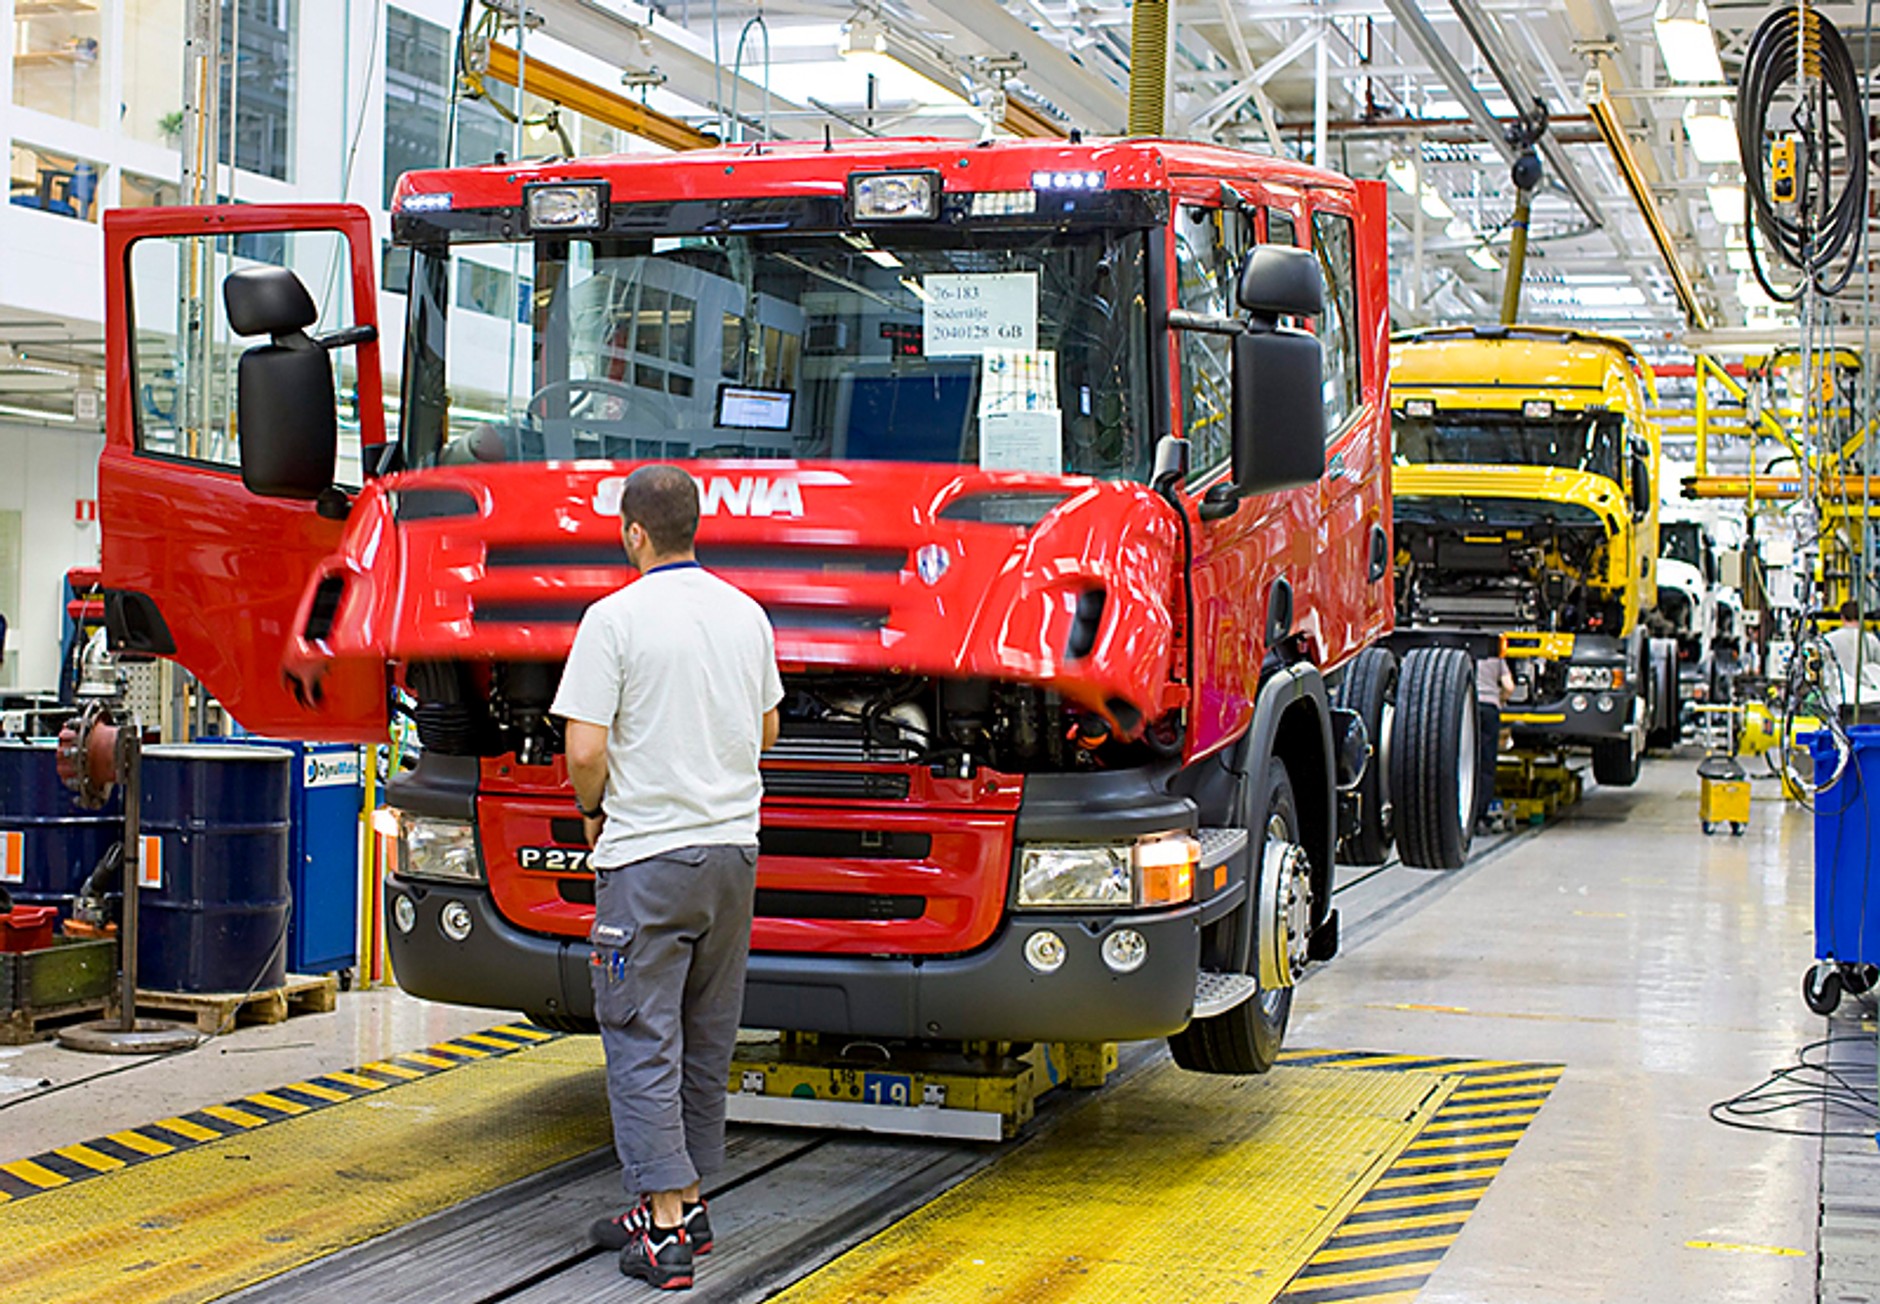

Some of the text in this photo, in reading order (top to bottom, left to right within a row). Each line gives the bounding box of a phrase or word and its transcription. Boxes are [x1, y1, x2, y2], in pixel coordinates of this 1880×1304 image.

[997, 324, 1023, 339] GB
[592, 475, 804, 517] SNIA
[522, 848, 541, 869] P
[868, 1080, 907, 1107] 19
